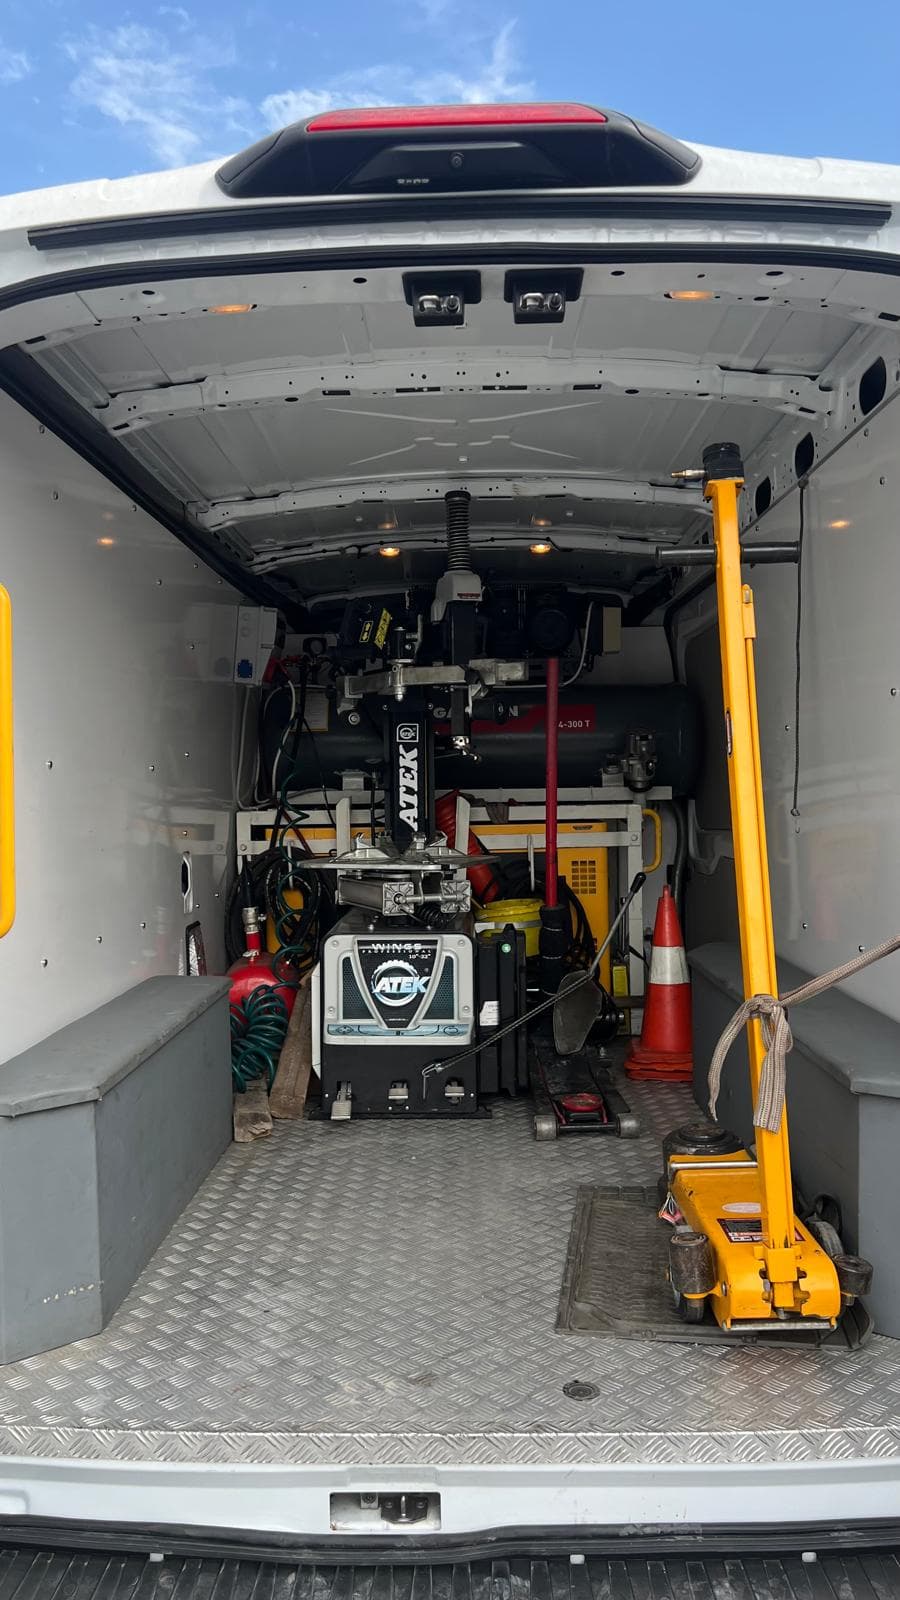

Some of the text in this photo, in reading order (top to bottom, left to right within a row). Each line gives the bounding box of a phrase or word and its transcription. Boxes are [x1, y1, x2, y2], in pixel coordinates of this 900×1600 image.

[584, 719, 591, 728] T
[399, 744, 419, 832] ATEK
[372, 976, 432, 993] ATEK
